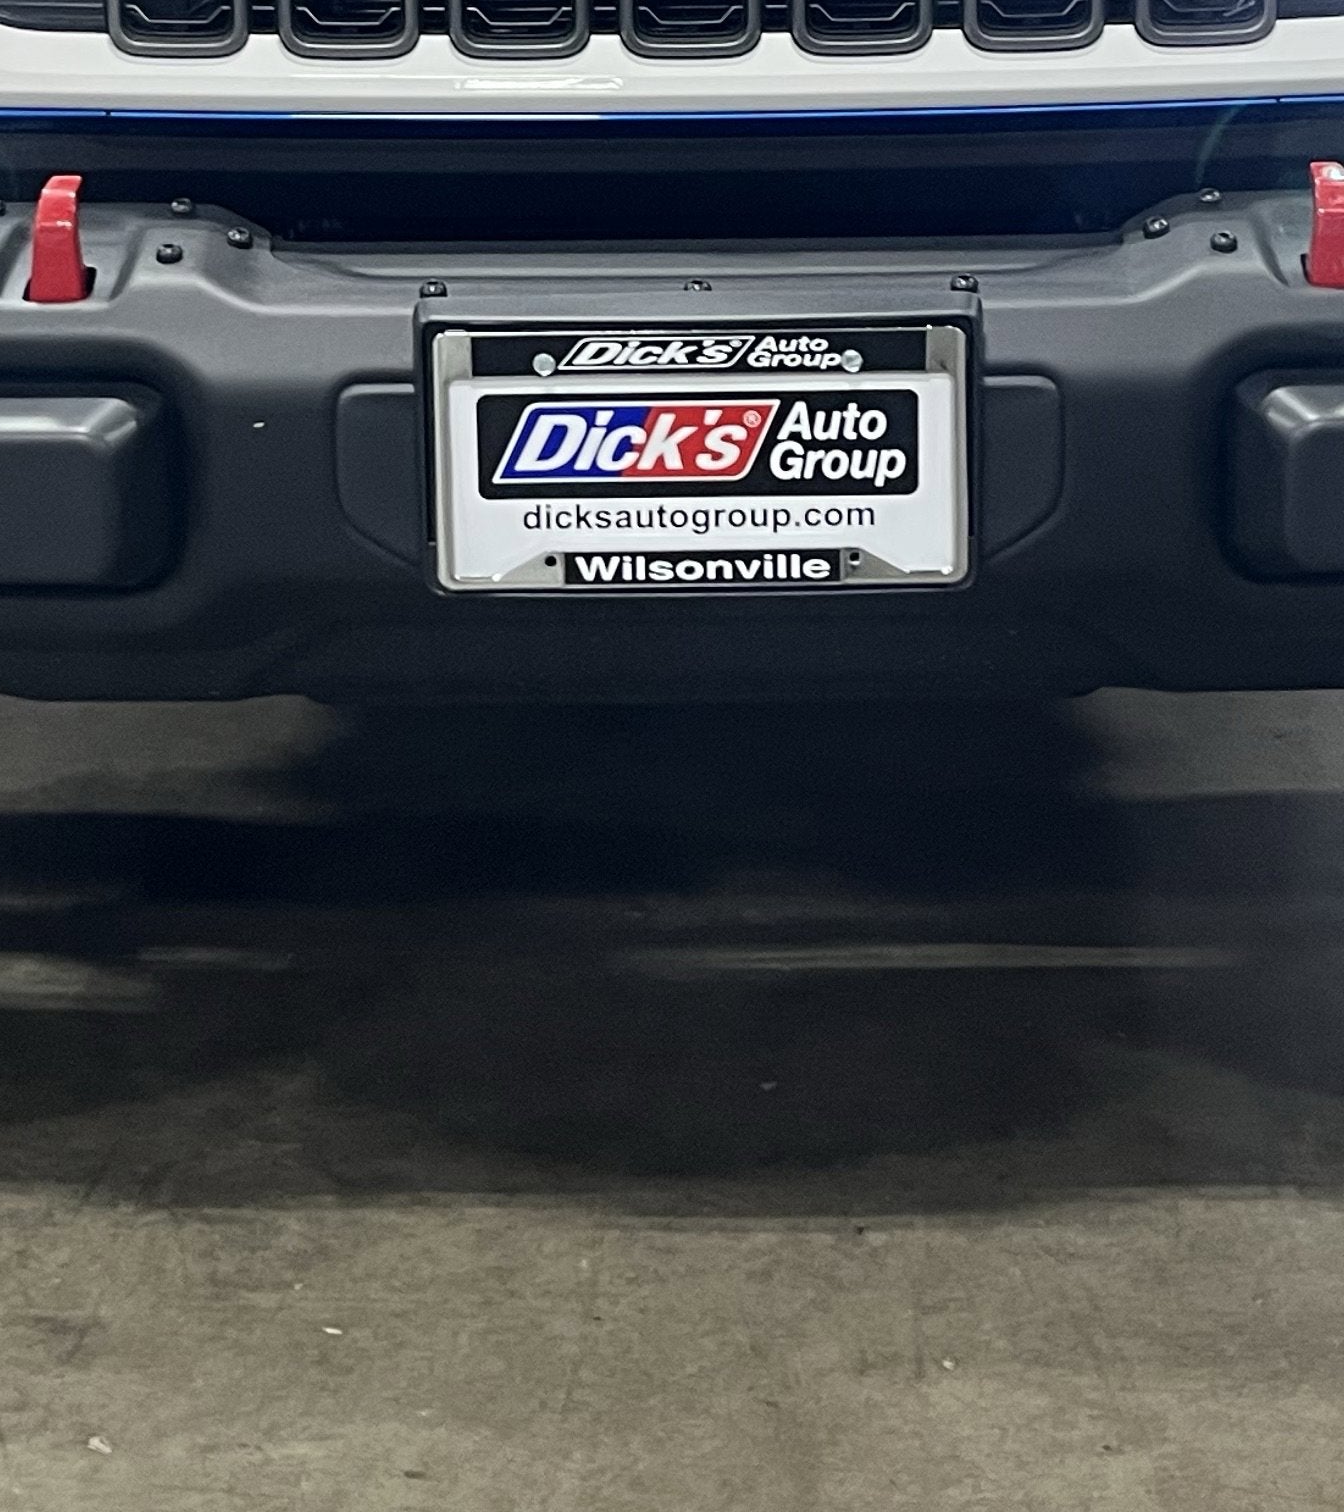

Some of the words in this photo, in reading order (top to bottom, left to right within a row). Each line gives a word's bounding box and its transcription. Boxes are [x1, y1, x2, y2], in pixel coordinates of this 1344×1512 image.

[571, 340, 736, 365] Dick's
[754, 335, 829, 353] Auto
[747, 351, 842, 369] Group
[514, 409, 748, 472] Dick's
[777, 401, 887, 441] Auto
[769, 440, 907, 488] Group
[523, 503, 876, 534] dicksautogroup.com
[574, 552, 832, 583] Wilsonville
